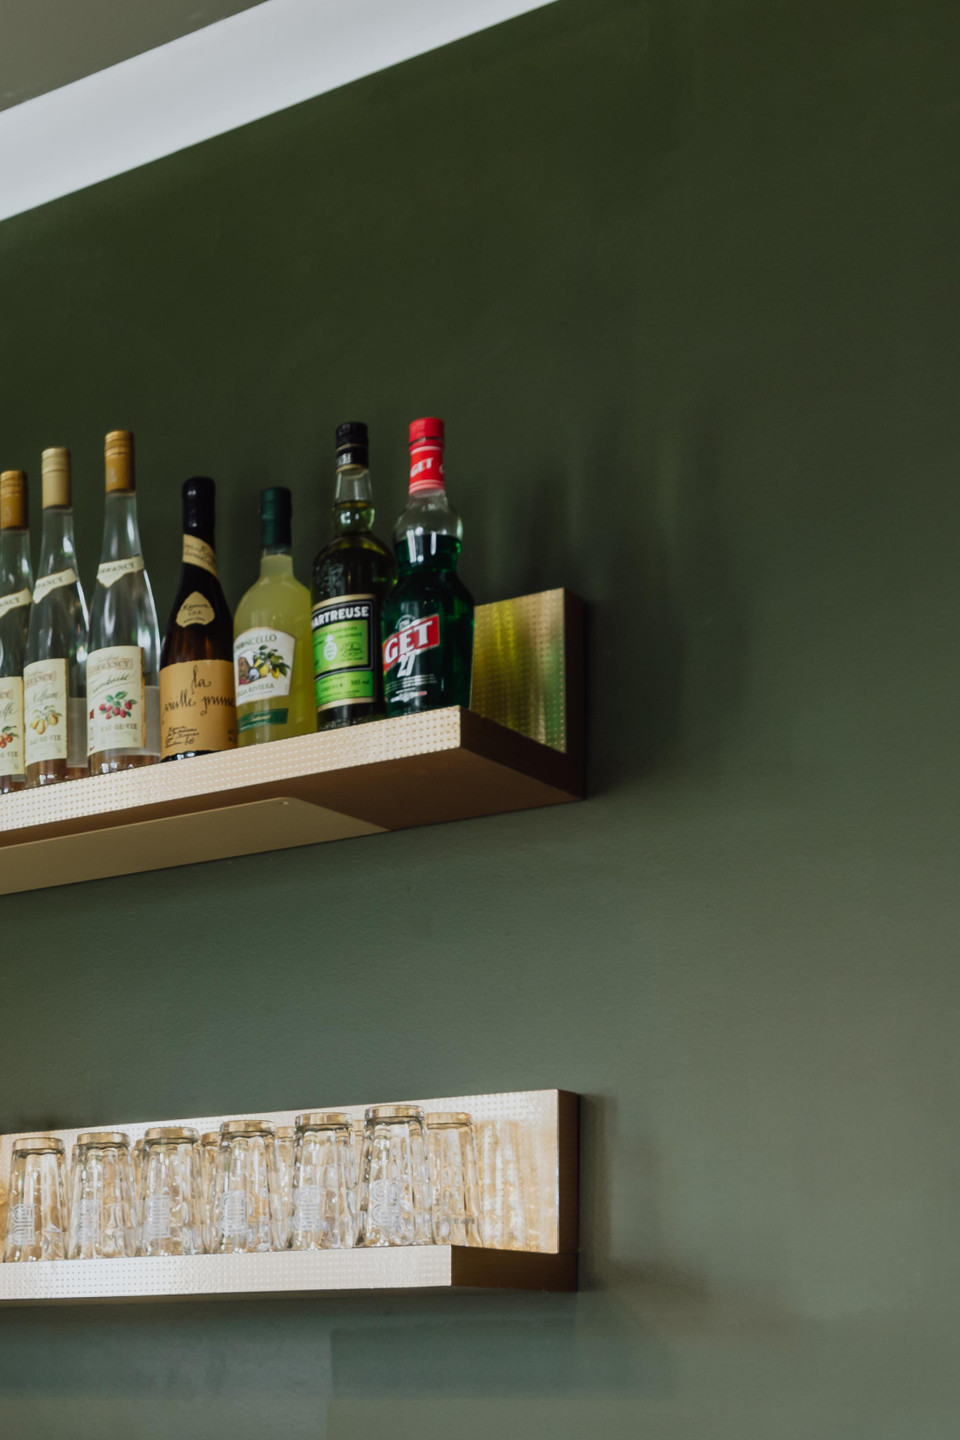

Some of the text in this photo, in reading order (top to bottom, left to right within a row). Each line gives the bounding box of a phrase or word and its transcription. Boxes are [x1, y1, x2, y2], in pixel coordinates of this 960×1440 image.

[410, 457, 434, 478] GET
[311, 605, 370, 632] ARTREUSE
[383, 621, 434, 664] GET
[396, 648, 417, 679] 27
